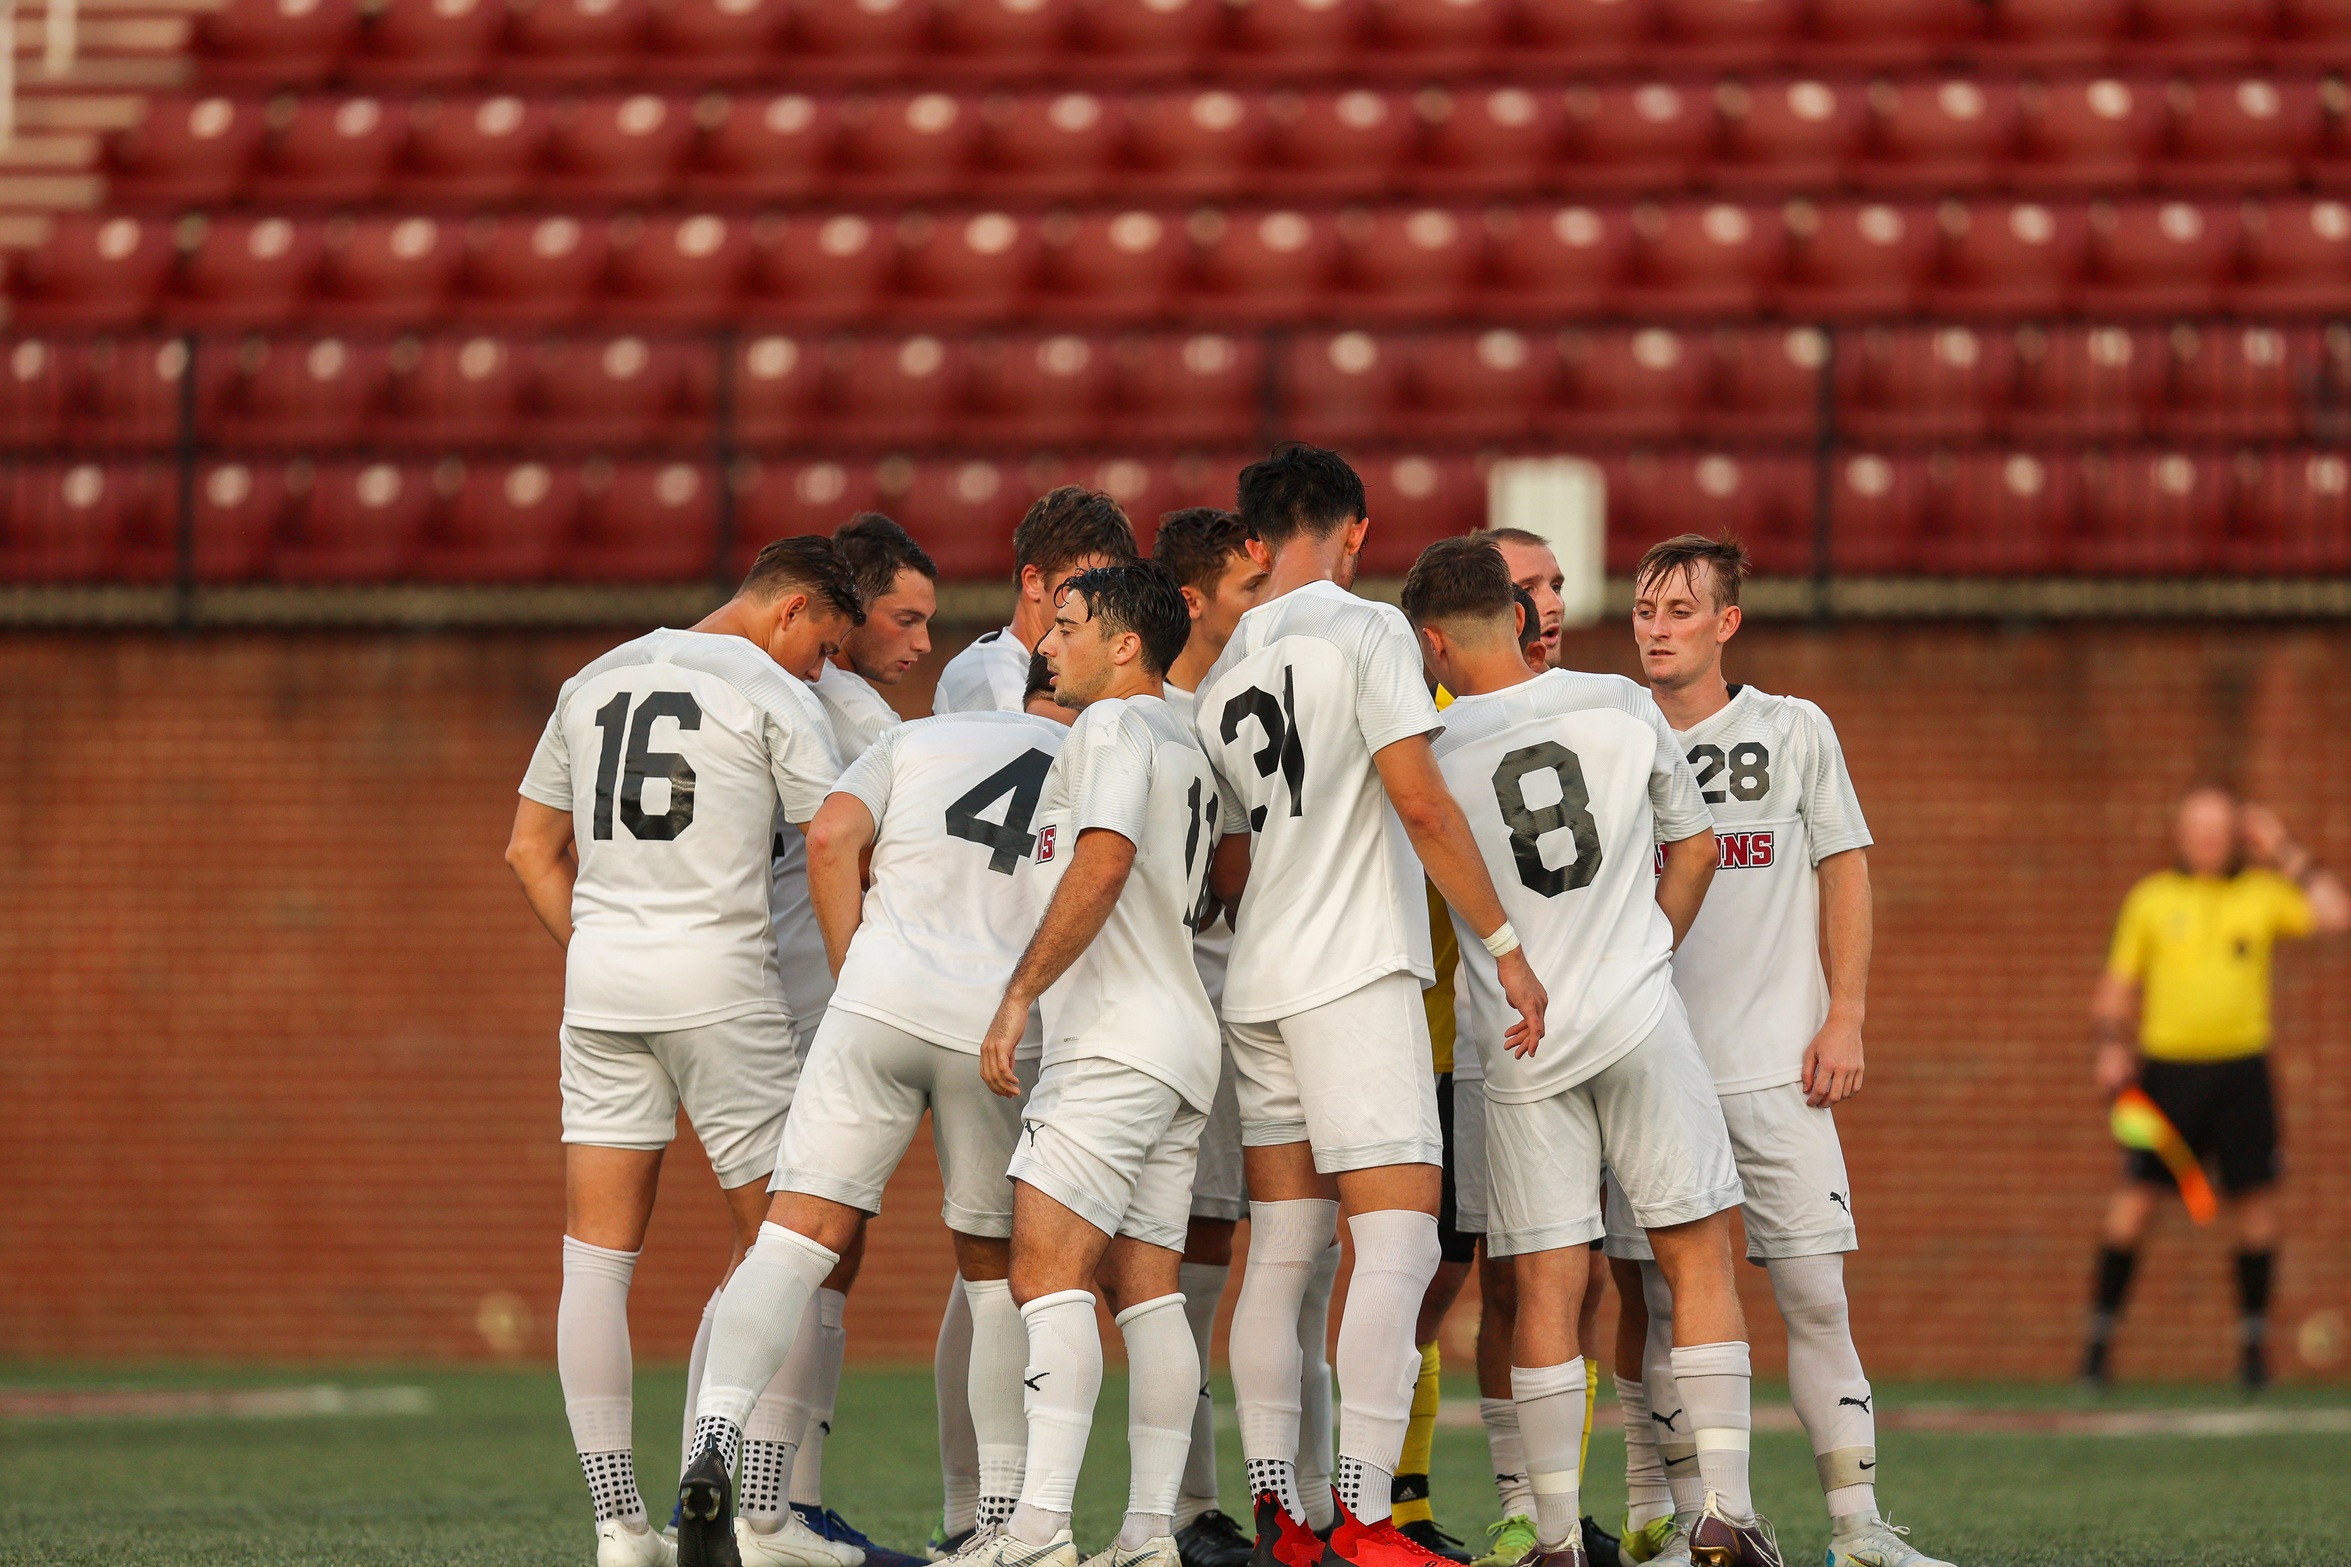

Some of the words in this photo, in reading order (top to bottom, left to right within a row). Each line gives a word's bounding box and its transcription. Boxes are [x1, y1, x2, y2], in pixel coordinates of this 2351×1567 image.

[594, 692, 702, 840] 16
[945, 747, 1054, 876] 4
[1492, 741, 1603, 898] 8
[1686, 742, 1770, 804] 28
